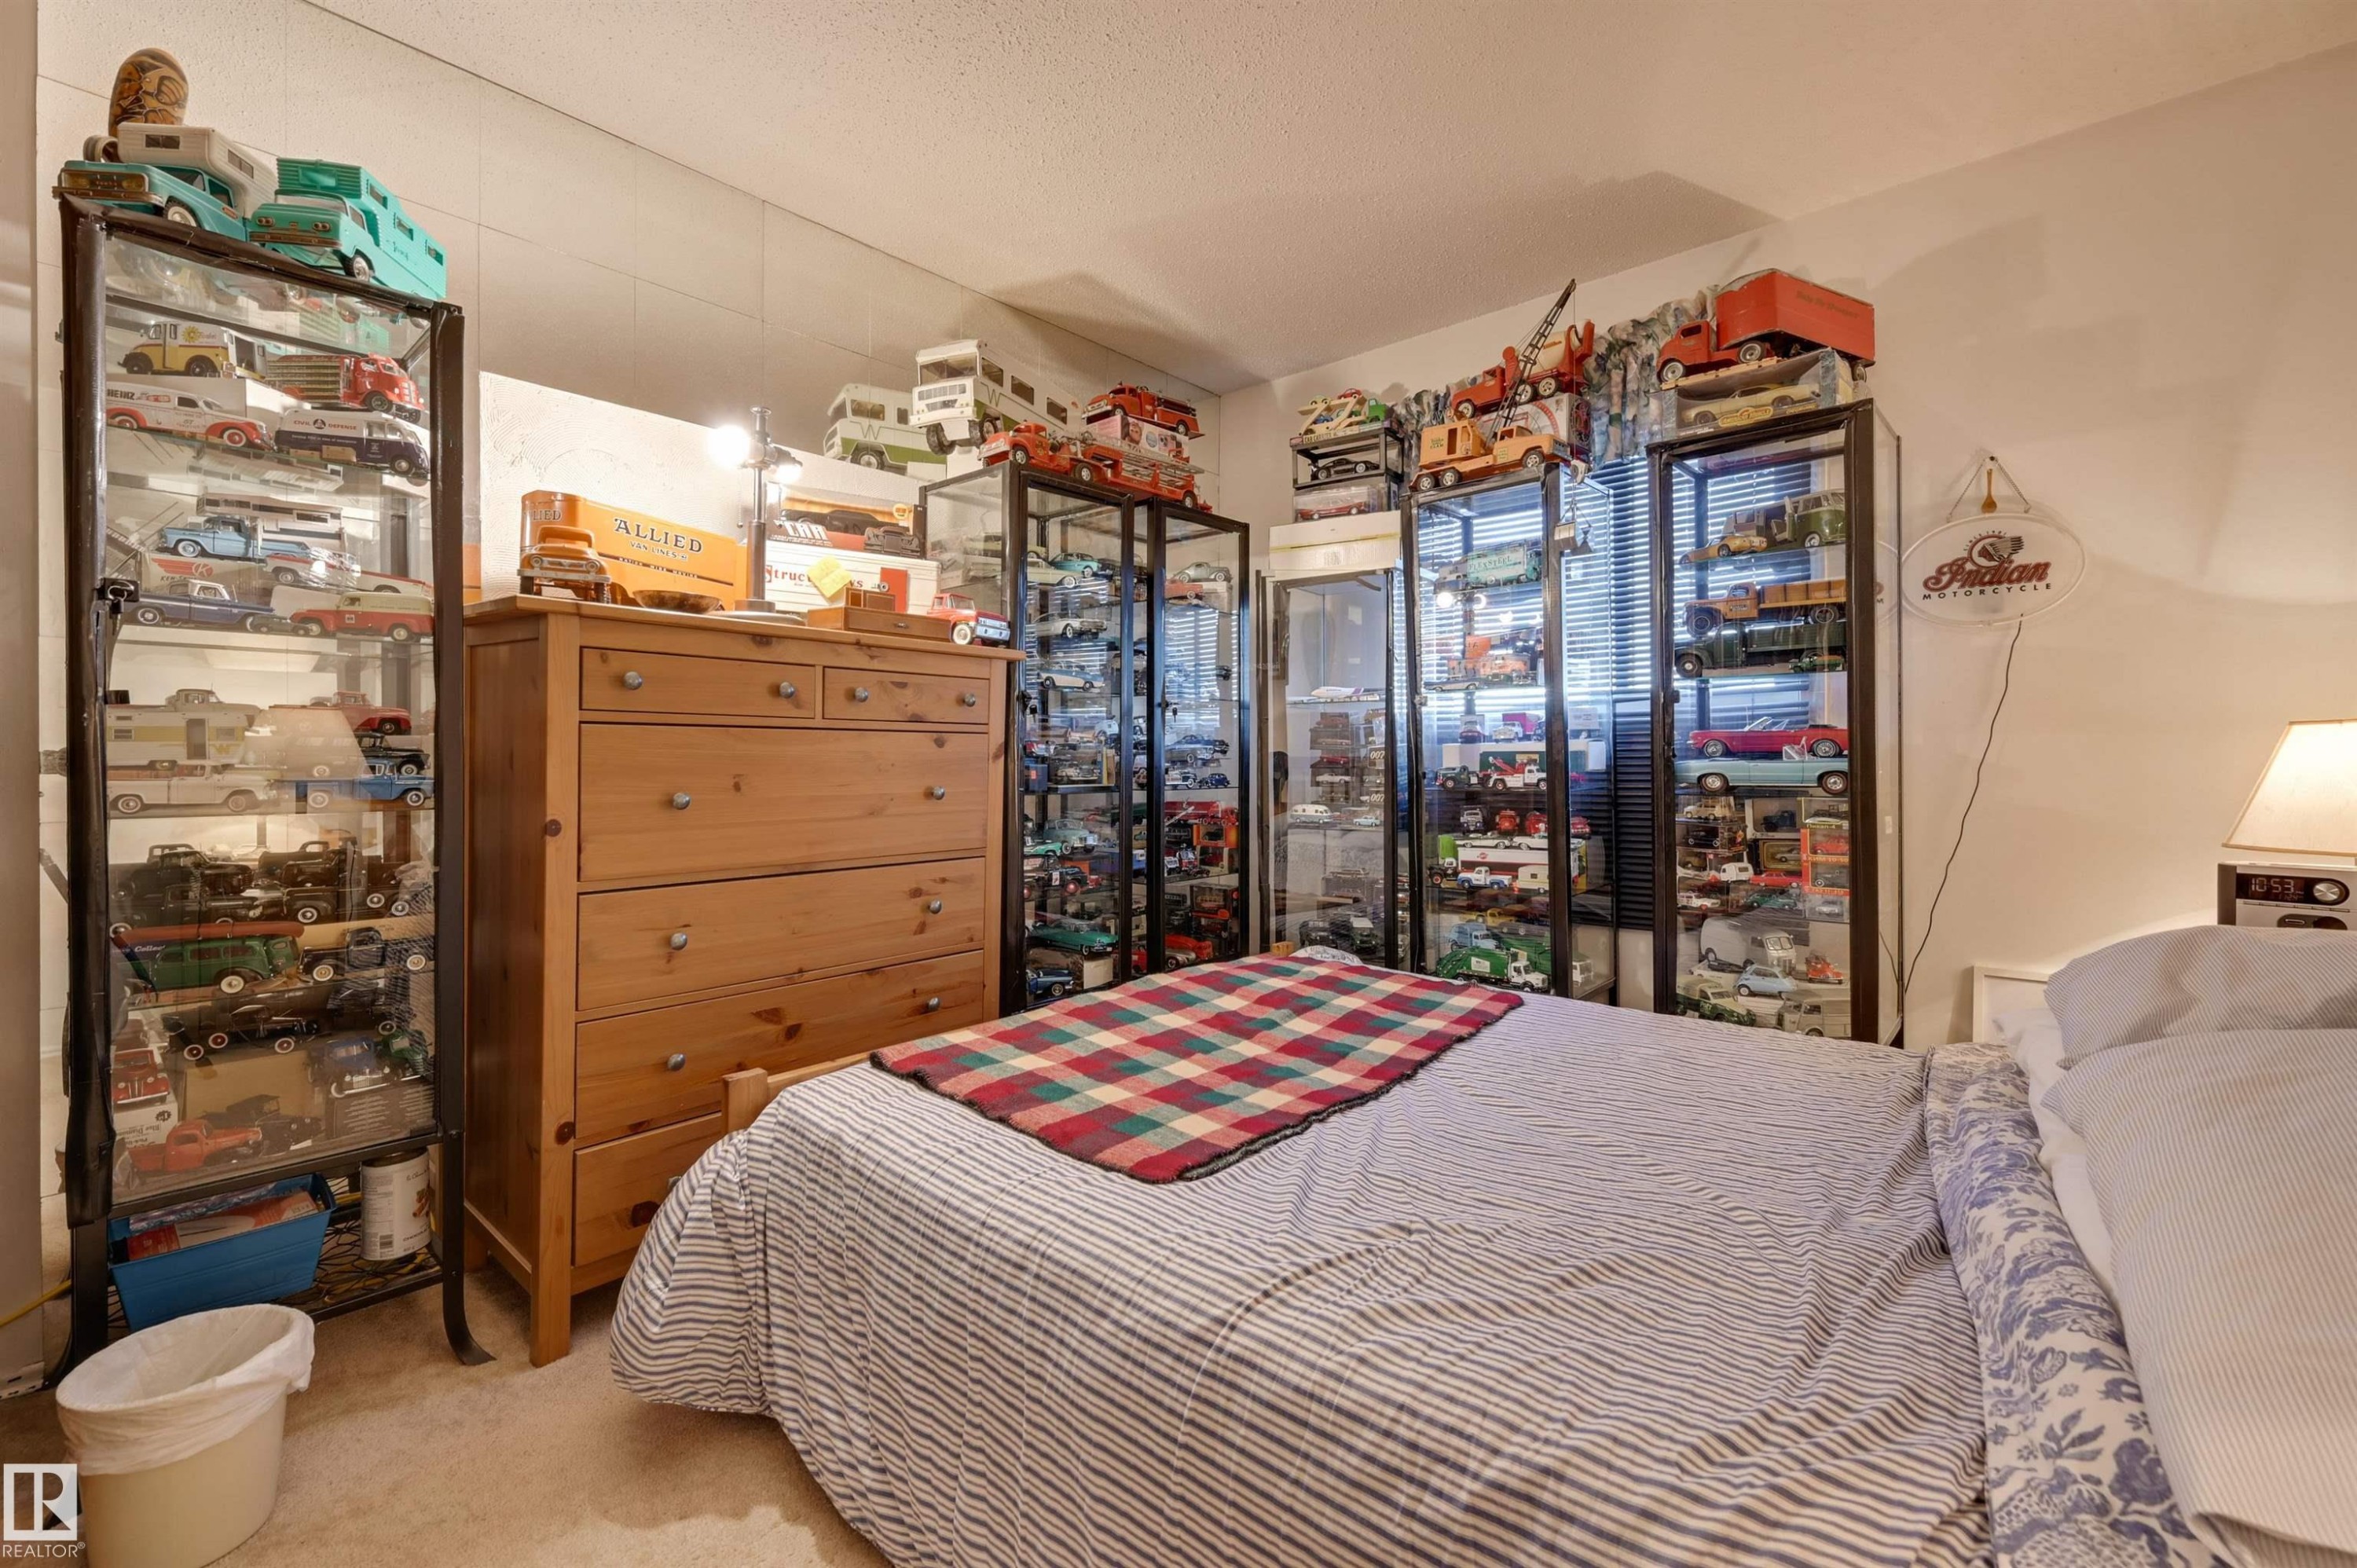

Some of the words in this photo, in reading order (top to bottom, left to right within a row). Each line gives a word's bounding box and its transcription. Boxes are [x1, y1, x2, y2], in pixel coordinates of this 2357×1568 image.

[107, 389, 136, 401] HEINZ
[614, 518, 703, 553] ALLIED
[630, 540, 648, 551] VAN
[651, 547, 677, 559] LINES
[1923, 555, 2052, 593] Indian
[1922, 583, 2052, 601] MOTORCYCLE
[1369, 750, 1385, 760] 007
[1370, 793, 1385, 803] 007
